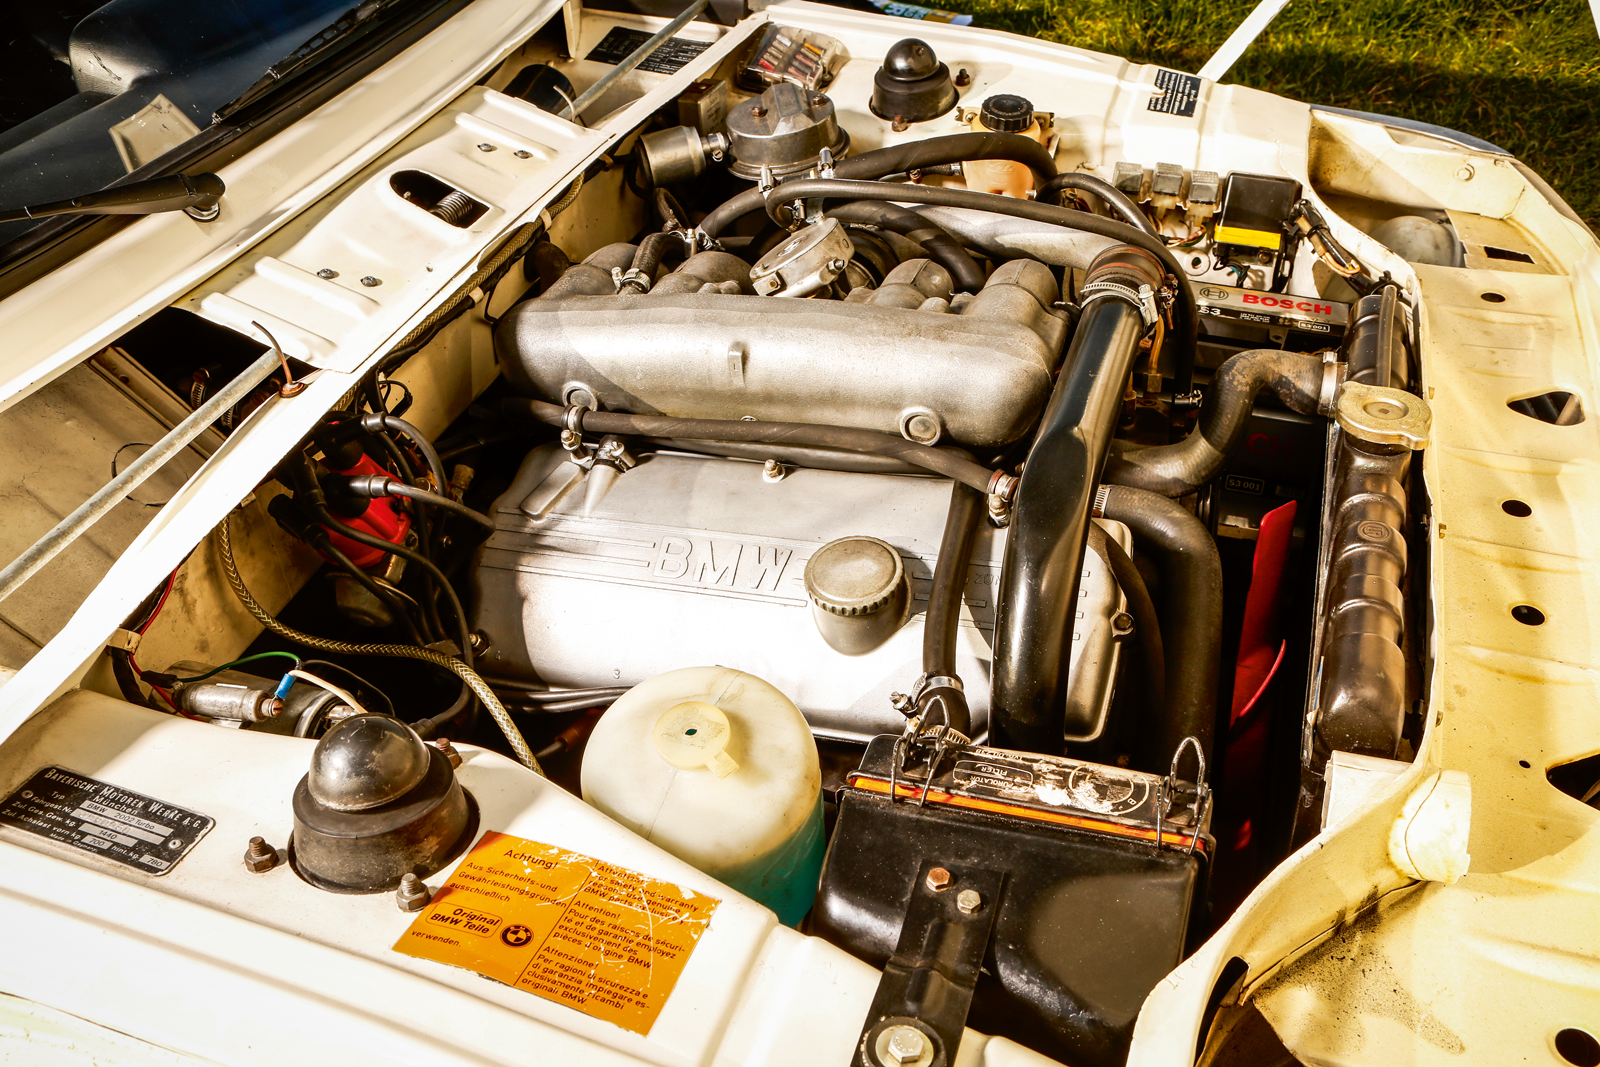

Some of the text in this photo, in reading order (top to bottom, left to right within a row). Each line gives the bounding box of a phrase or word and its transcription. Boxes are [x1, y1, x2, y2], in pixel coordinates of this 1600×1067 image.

[1199, 306, 1221, 316] S3
[1242, 294, 1332, 315] BOSCH
[1228, 479, 1260, 491] S3 001
[653, 536, 793, 591] BMW
[613, 668, 621, 679] 3
[981, 766, 1008, 776] FILTER
[44, 768, 98, 793] BAYERISCHE
[100, 786, 145, 809] MOTOREN
[147, 801, 182, 821] WERKE
[93, 796, 138, 816] München
[52, 791, 155, 831] Typ BMW 2002 Turbo
[28, 806, 44, 816] Ges.
[65, 817, 76, 827] kg.
[98, 829, 118, 840] 1440
[18, 814, 52, 829] Achslast
[53, 826, 70, 835] vorn
[71, 831, 81, 840] kg.
[88, 837, 106, 847] 700
[111, 844, 128, 855] hint.
[146, 857, 163, 867] 780
[503, 849, 559, 870] Achtung!
[466, 861, 559, 893] Aus Sicherheits-und
[450, 881, 511, 902] ausschließlich
[458, 871, 567, 909] Gewährleistungsgründen
[583, 886, 609, 899] BMW
[608, 895, 633, 908] parts
[573, 900, 621, 919] Attention!
[658, 894, 699, 913] warranty
[430, 913, 490, 935] BMW Teile
[452, 908, 501, 927] Original
[411, 930, 461, 948] verwenden.
[558, 923, 639, 956] exclusivement des
[563, 915, 677, 960] té et de garantie employez
[568, 908, 589, 921] Pour
[592, 915, 605, 926] des
[642, 933, 653, 943] de
[655, 938, 685, 953] sécuri-
[543, 945, 599, 970] Attenzione!
[552, 931, 652, 969] pièces d'origine BMW
[521, 977, 559, 996] originali
[532, 961, 650, 1010] di garanzia impiegare es-
[537, 953, 551, 964] Per
[554, 961, 586, 977] ragioni
[587, 971, 597, 980] di
[597, 975, 641, 998] sicurezza
[527, 969, 624, 1011] clusivamente ricambi
